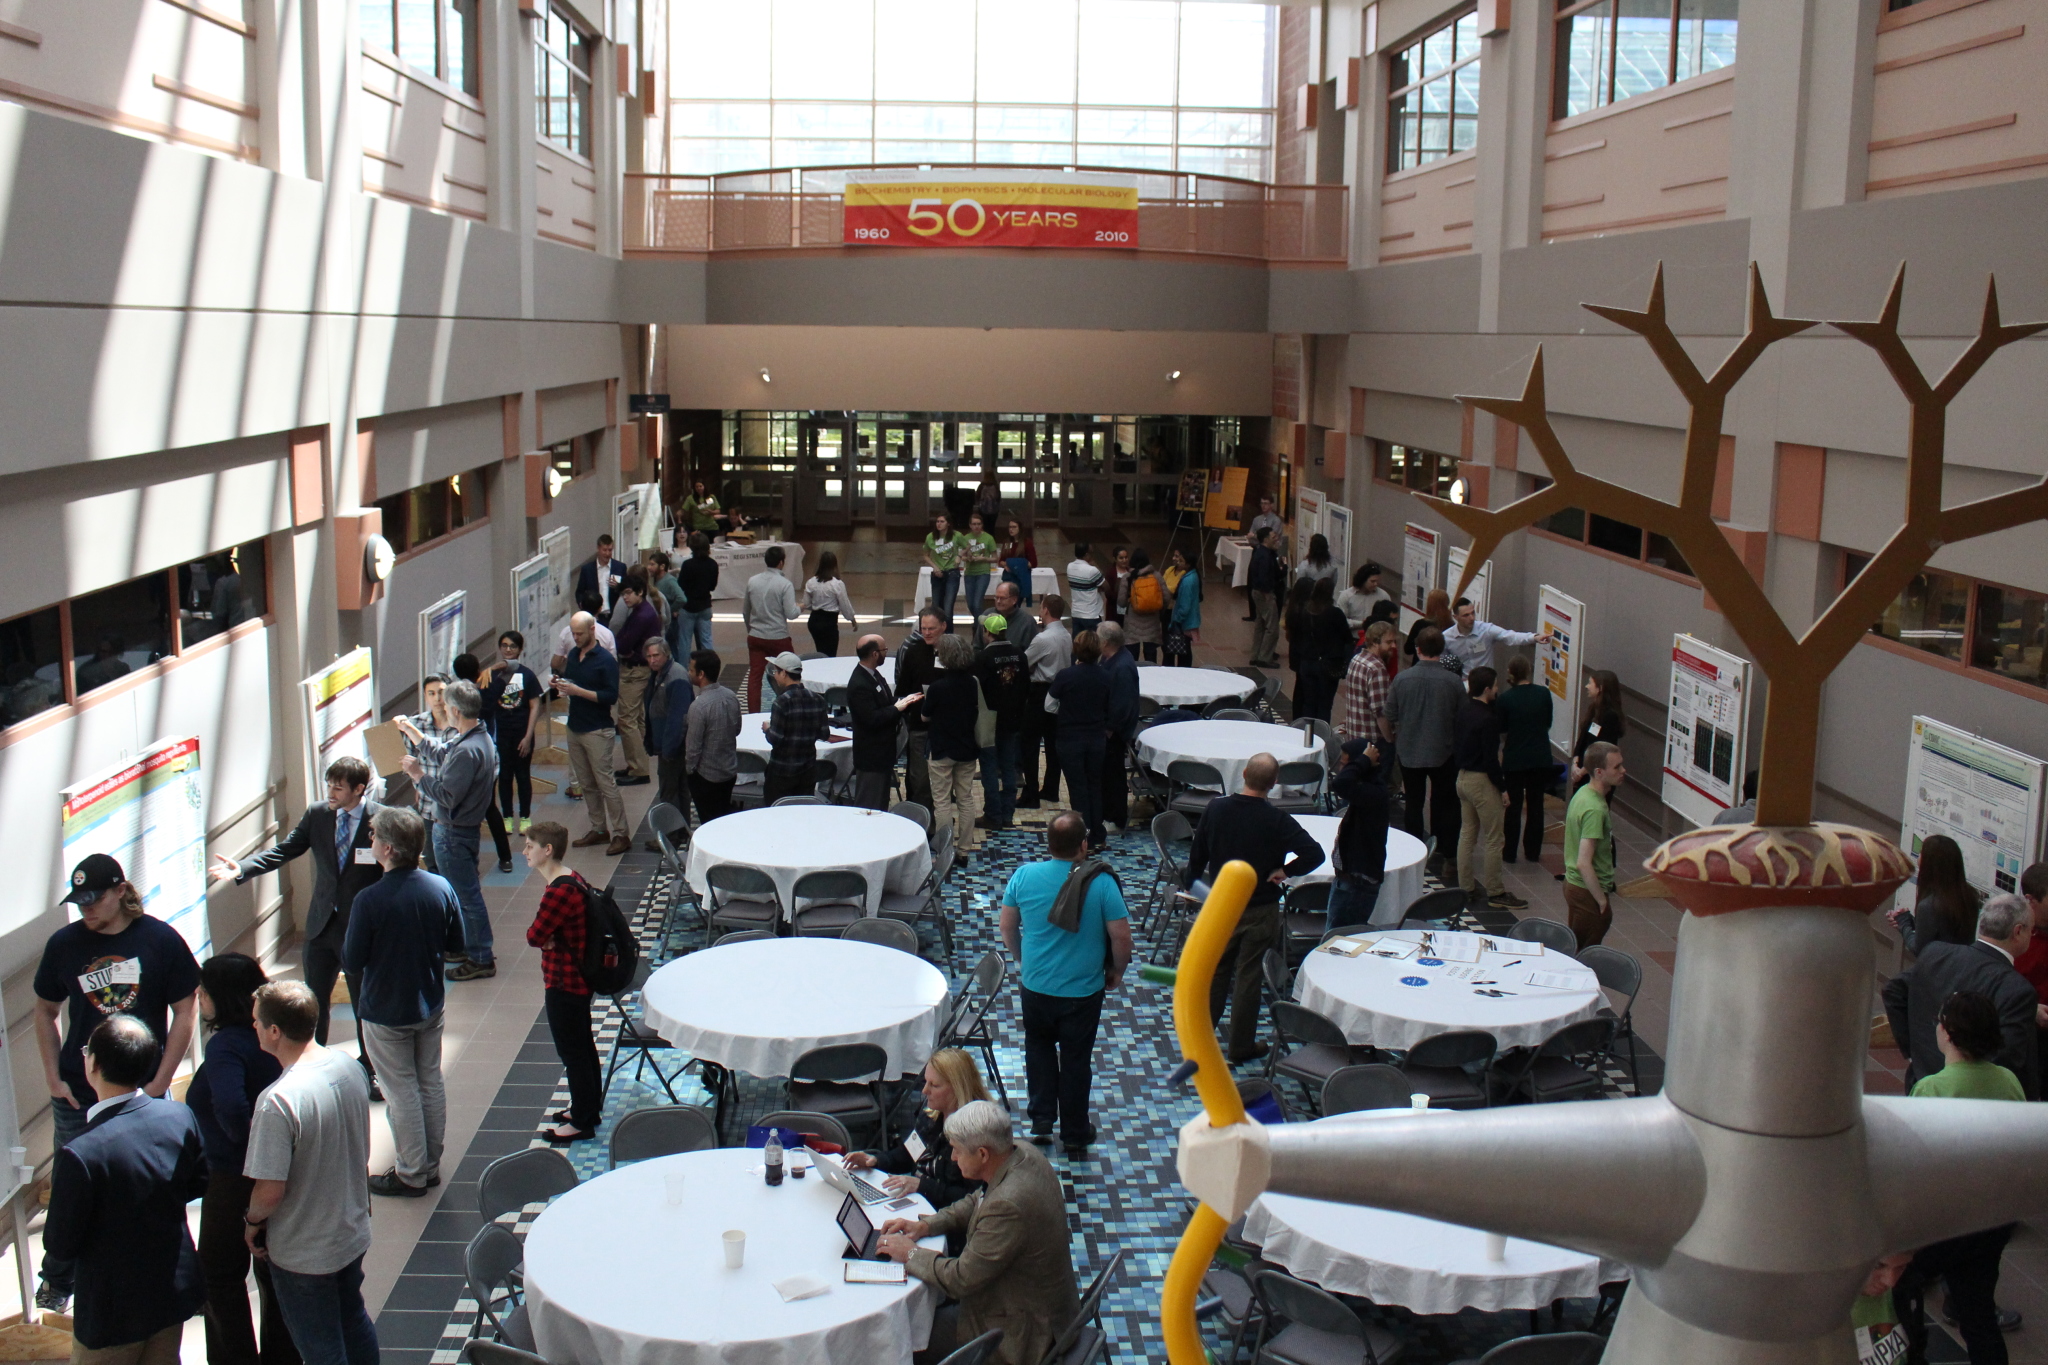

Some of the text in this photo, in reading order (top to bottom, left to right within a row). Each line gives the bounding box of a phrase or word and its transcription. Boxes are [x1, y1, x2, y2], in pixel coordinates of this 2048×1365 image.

[855, 185, 1129, 198] BIOCHEMISTRY BIOPHYSICS MOLECULAR BIOLOGY
[907, 198, 1079, 237] 50 YEARS
[854, 228, 890, 240] 1960
[1094, 230, 1129, 242] 2010
[122, 991, 136, 1007] 2017
[97, 1003, 120, 1014] APRIL
